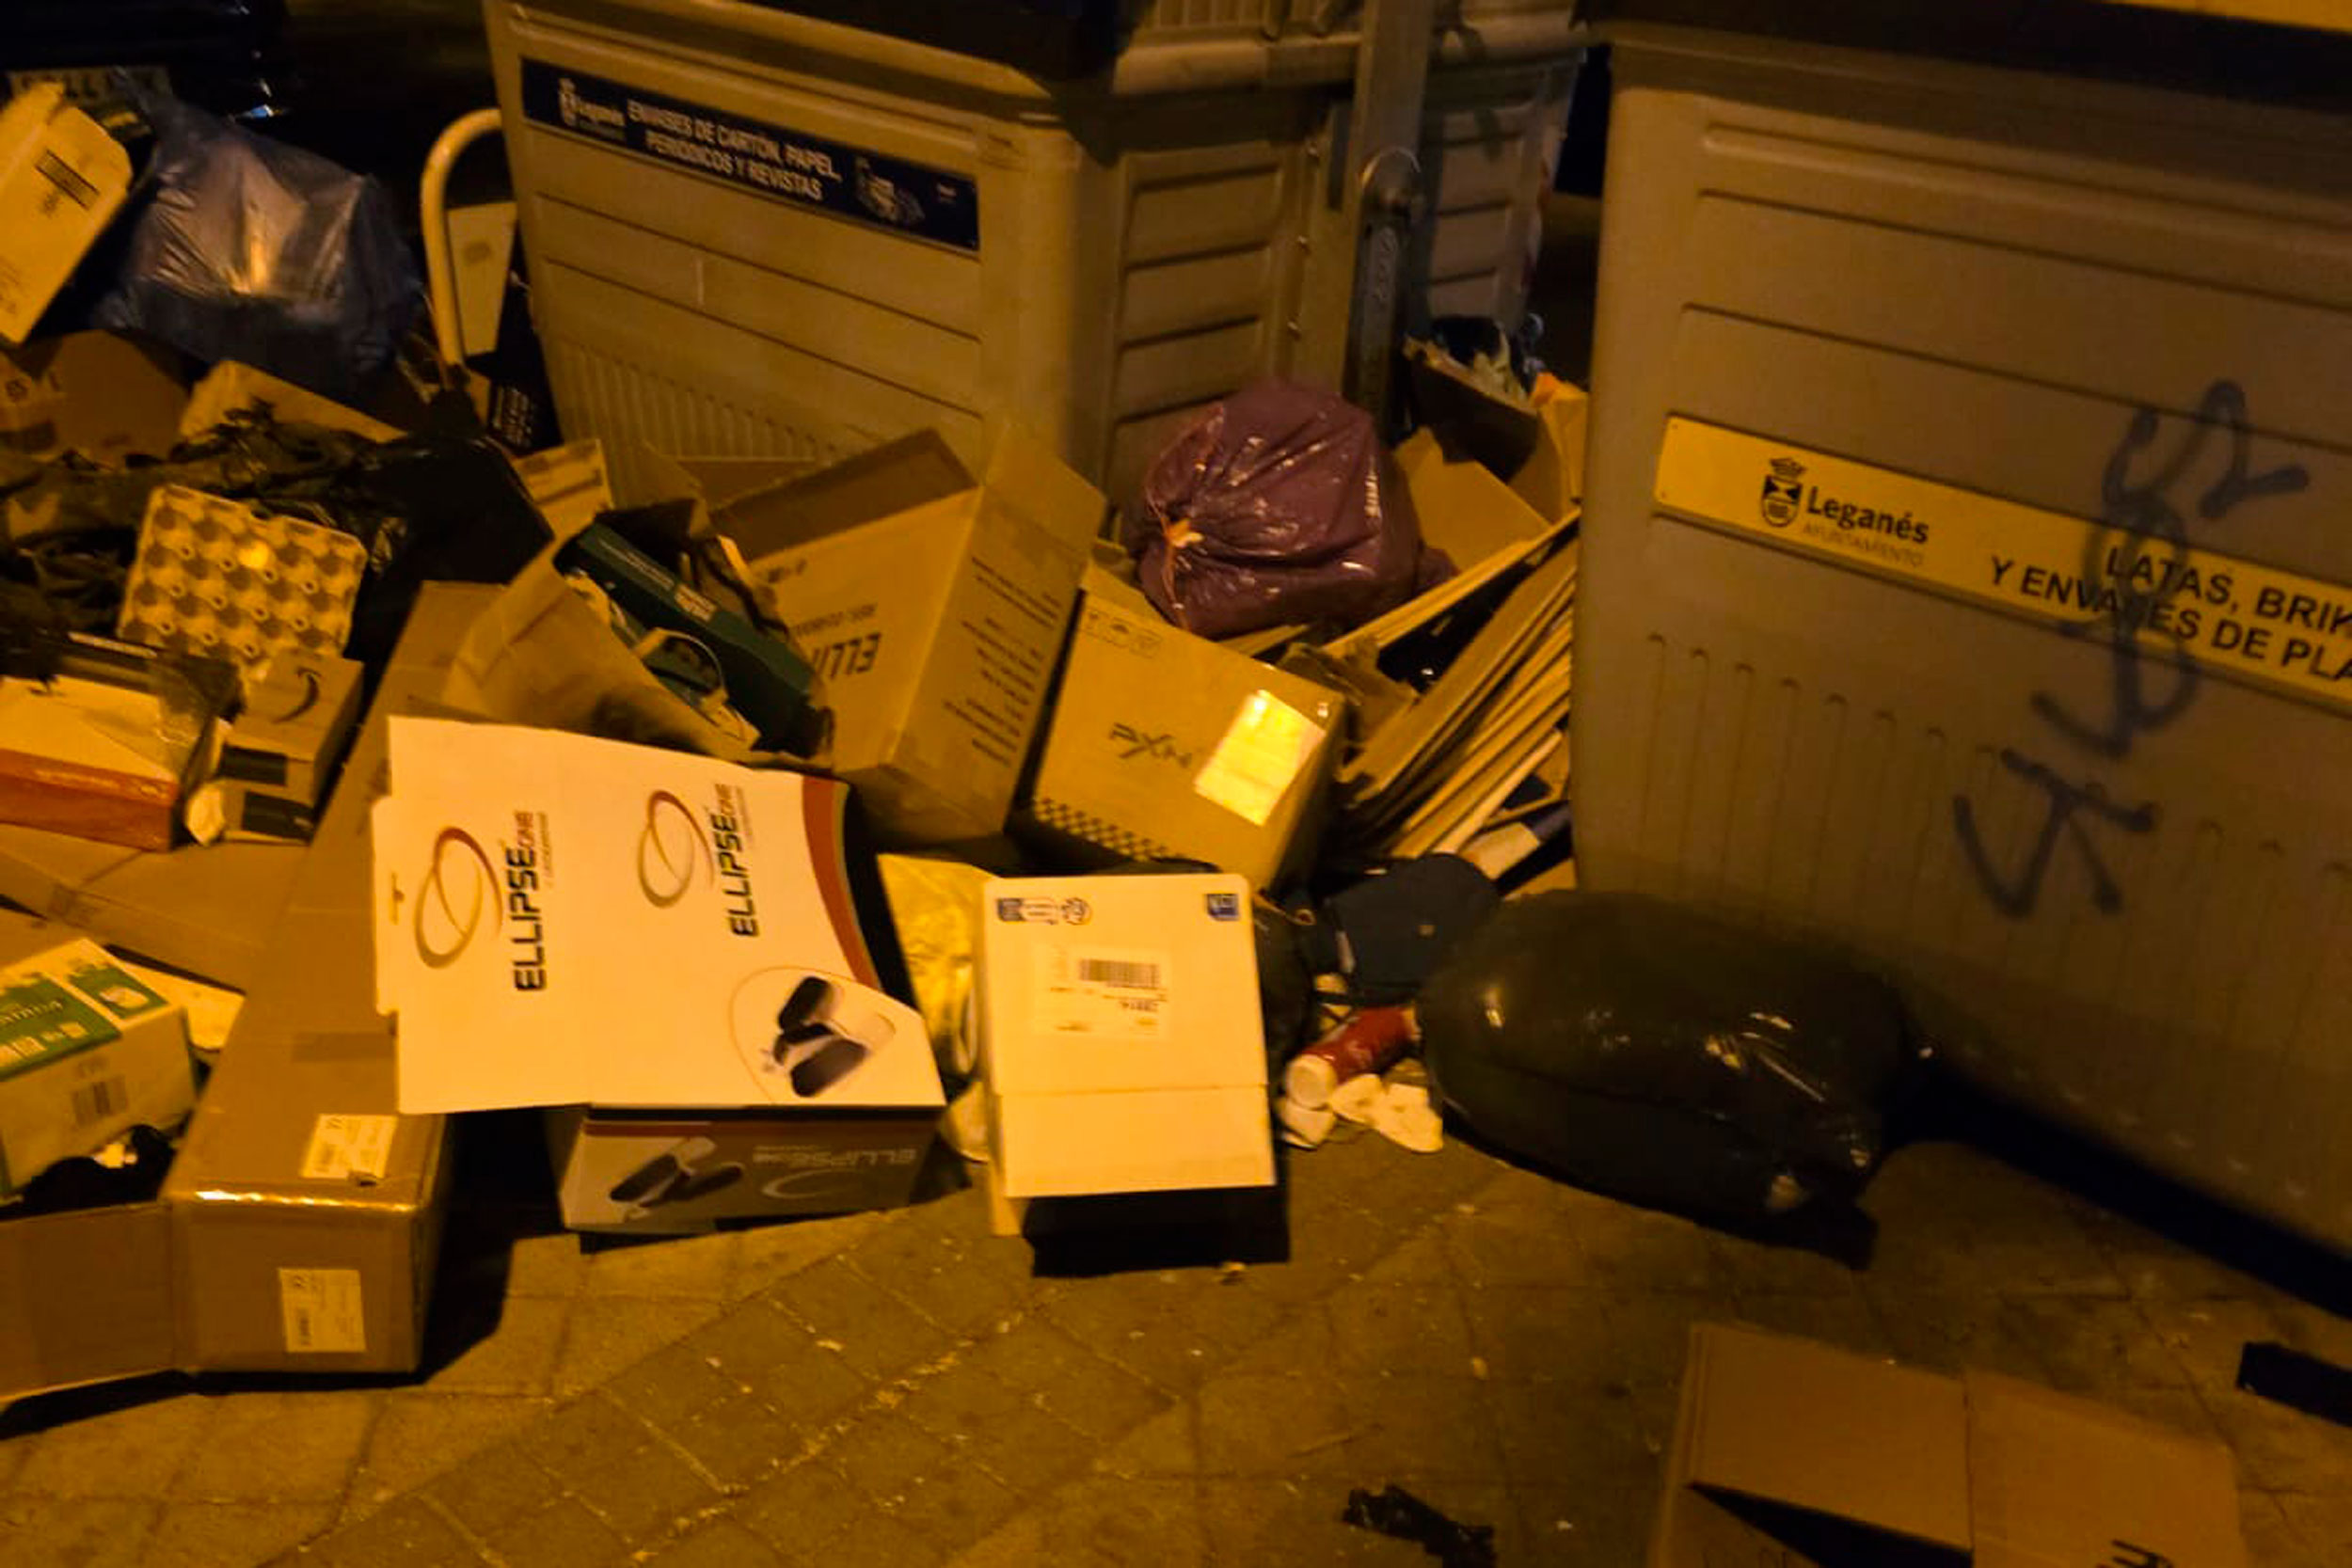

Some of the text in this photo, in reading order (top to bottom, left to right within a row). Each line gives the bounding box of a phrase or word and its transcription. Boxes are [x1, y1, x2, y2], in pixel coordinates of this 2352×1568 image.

[748, 159, 824, 201] REVISTAS
[1806, 485, 1929, 545] Leganés
[1990, 555, 2015, 586] Y
[2211, 618, 2273, 660] DE
[505, 847, 548, 991] ELLIPSE
[710, 813, 759, 938] ELLIPSE
